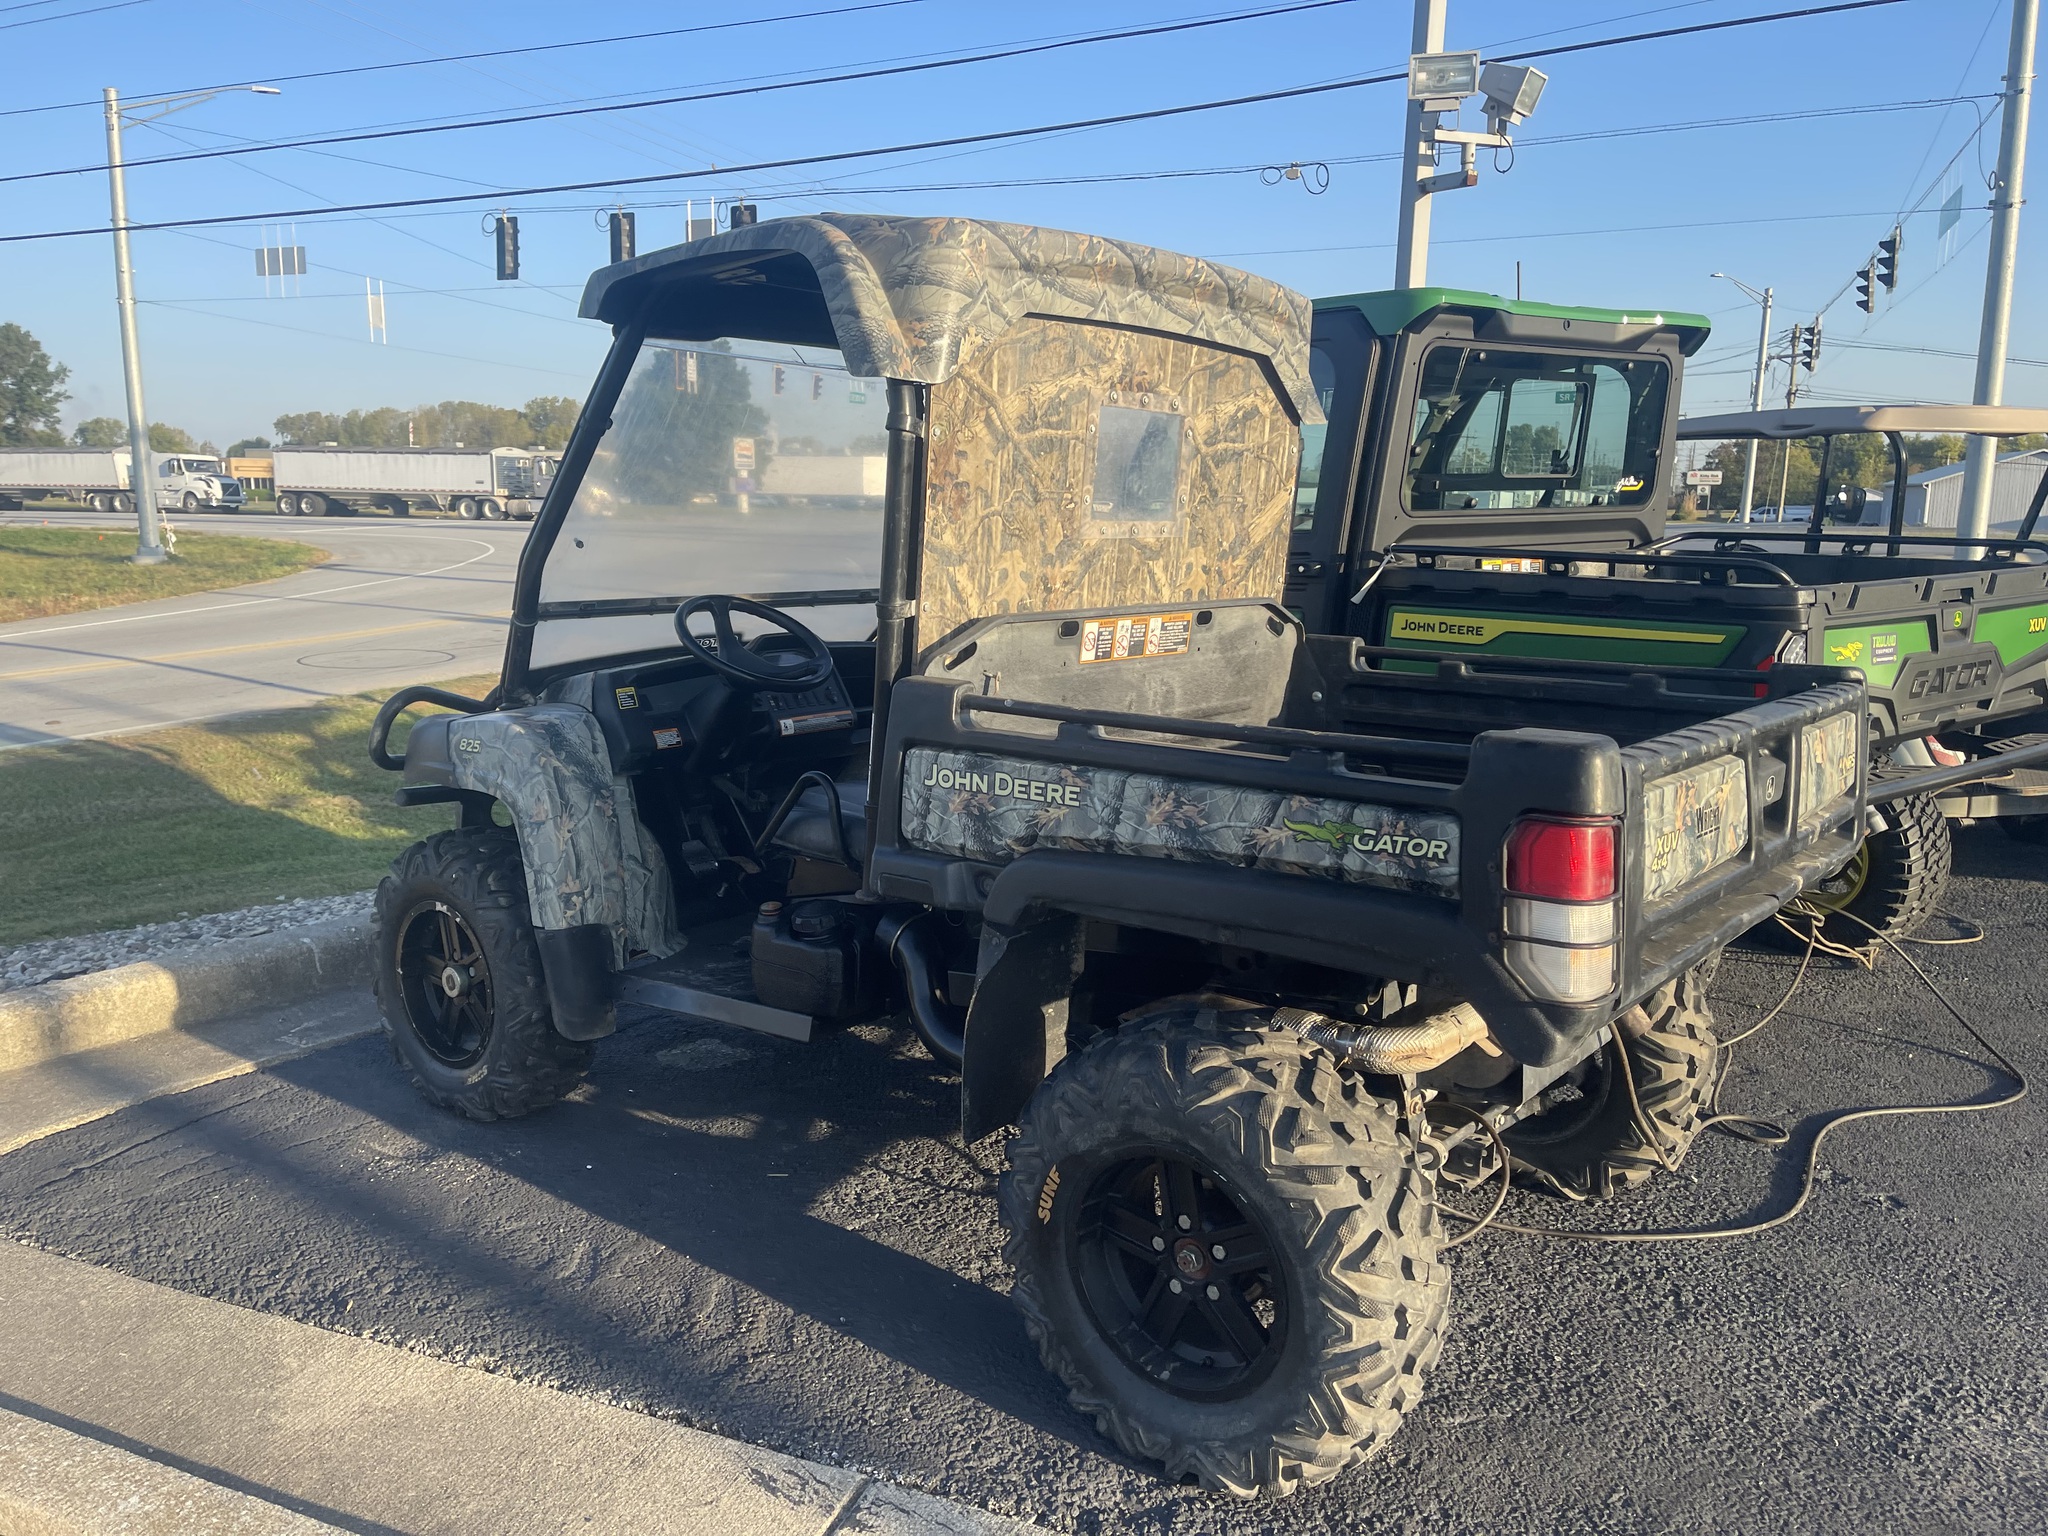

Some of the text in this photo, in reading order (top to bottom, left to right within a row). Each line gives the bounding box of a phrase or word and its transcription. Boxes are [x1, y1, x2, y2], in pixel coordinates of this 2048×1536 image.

[1559, 393, 1571, 401] SR
[1400, 619, 1484, 636] JOHN DEERE
[2028, 616, 2047, 633] XUV
[1908, 659, 1992, 700] GATOR
[924, 763, 1081, 807] JOHN DEERE
[1353, 828, 1448, 860] GATOR
[1655, 829, 1680, 857] XUV
[1651, 853, 1668, 872] 4x4
[1037, 1163, 1061, 1225] SUNF
